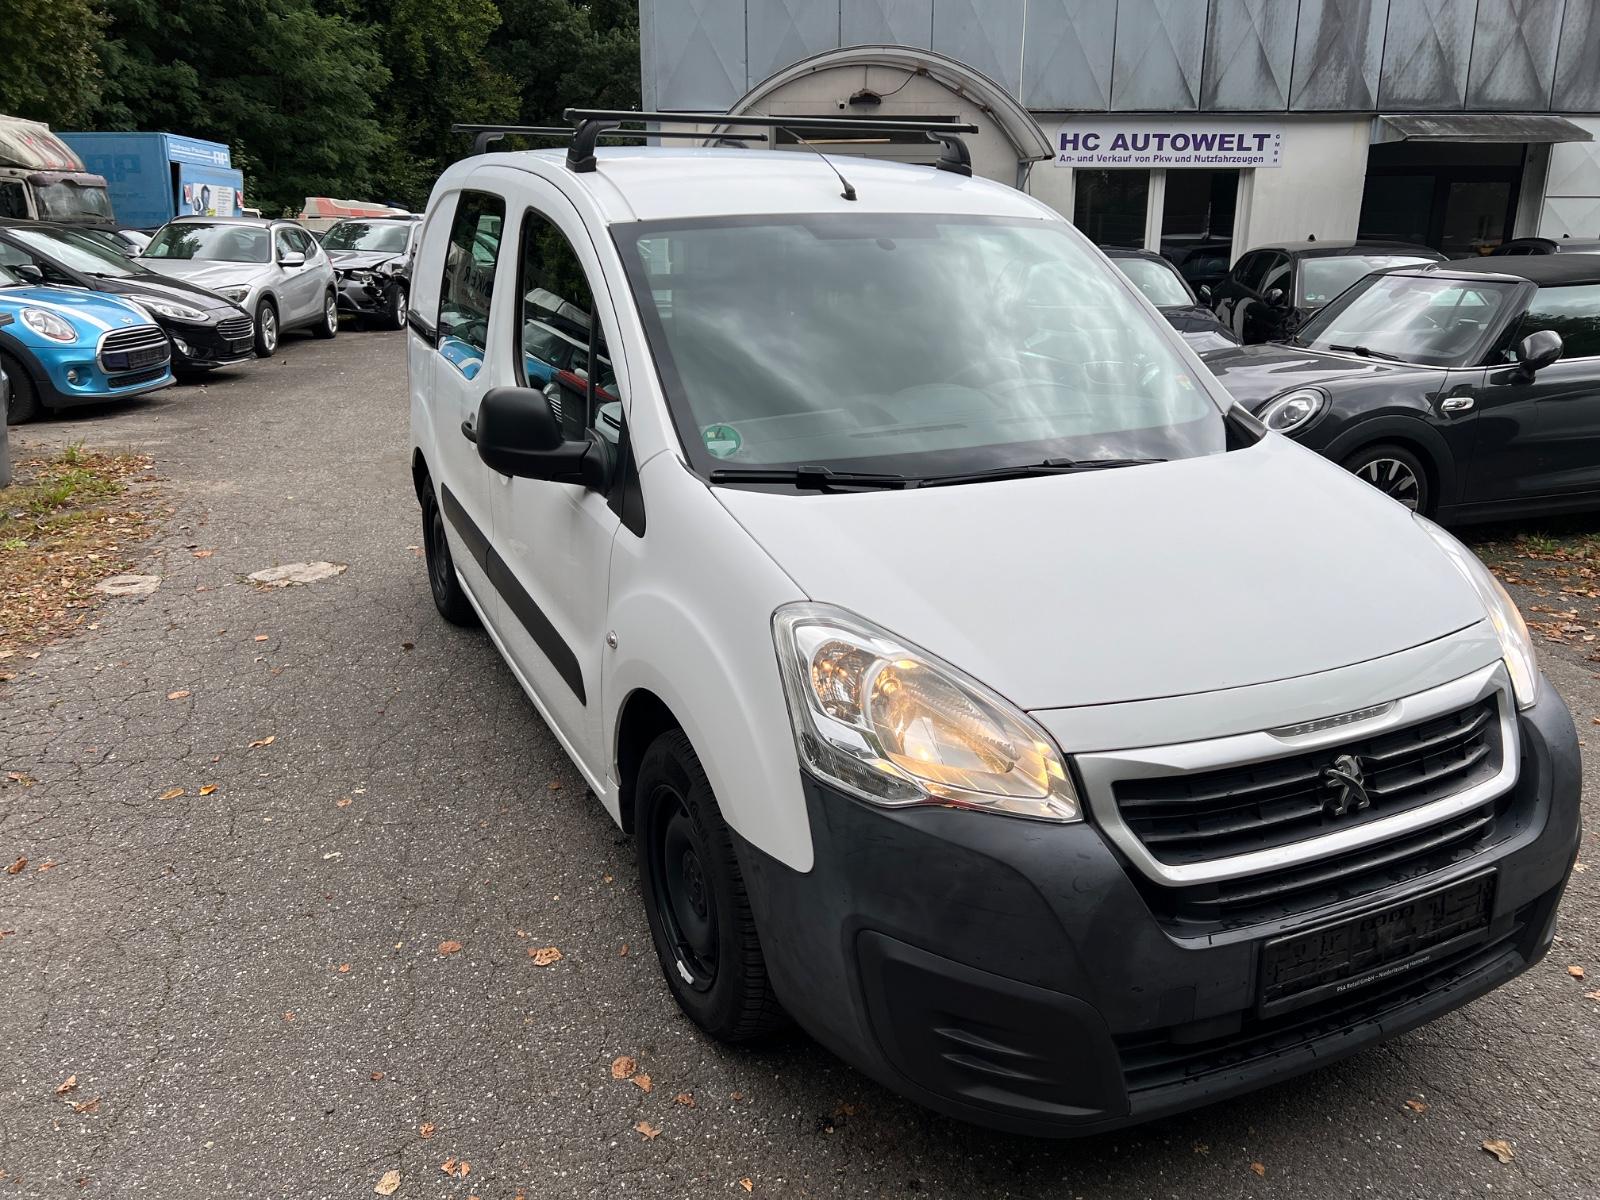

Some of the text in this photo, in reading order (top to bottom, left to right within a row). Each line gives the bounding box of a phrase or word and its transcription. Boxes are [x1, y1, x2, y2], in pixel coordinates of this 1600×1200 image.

[1059, 133, 1271, 152] HC AUTOWELT
[1059, 154, 1075, 163] An-
[1077, 154, 1093, 163] und
[1097, 154, 1132, 163] Verkauf
[1153, 155, 1172, 163] Pkw
[1175, 155, 1191, 163] und
[1194, 154, 1264, 165] Nutzfahrzeugen
[715, 427, 726, 440] 4
